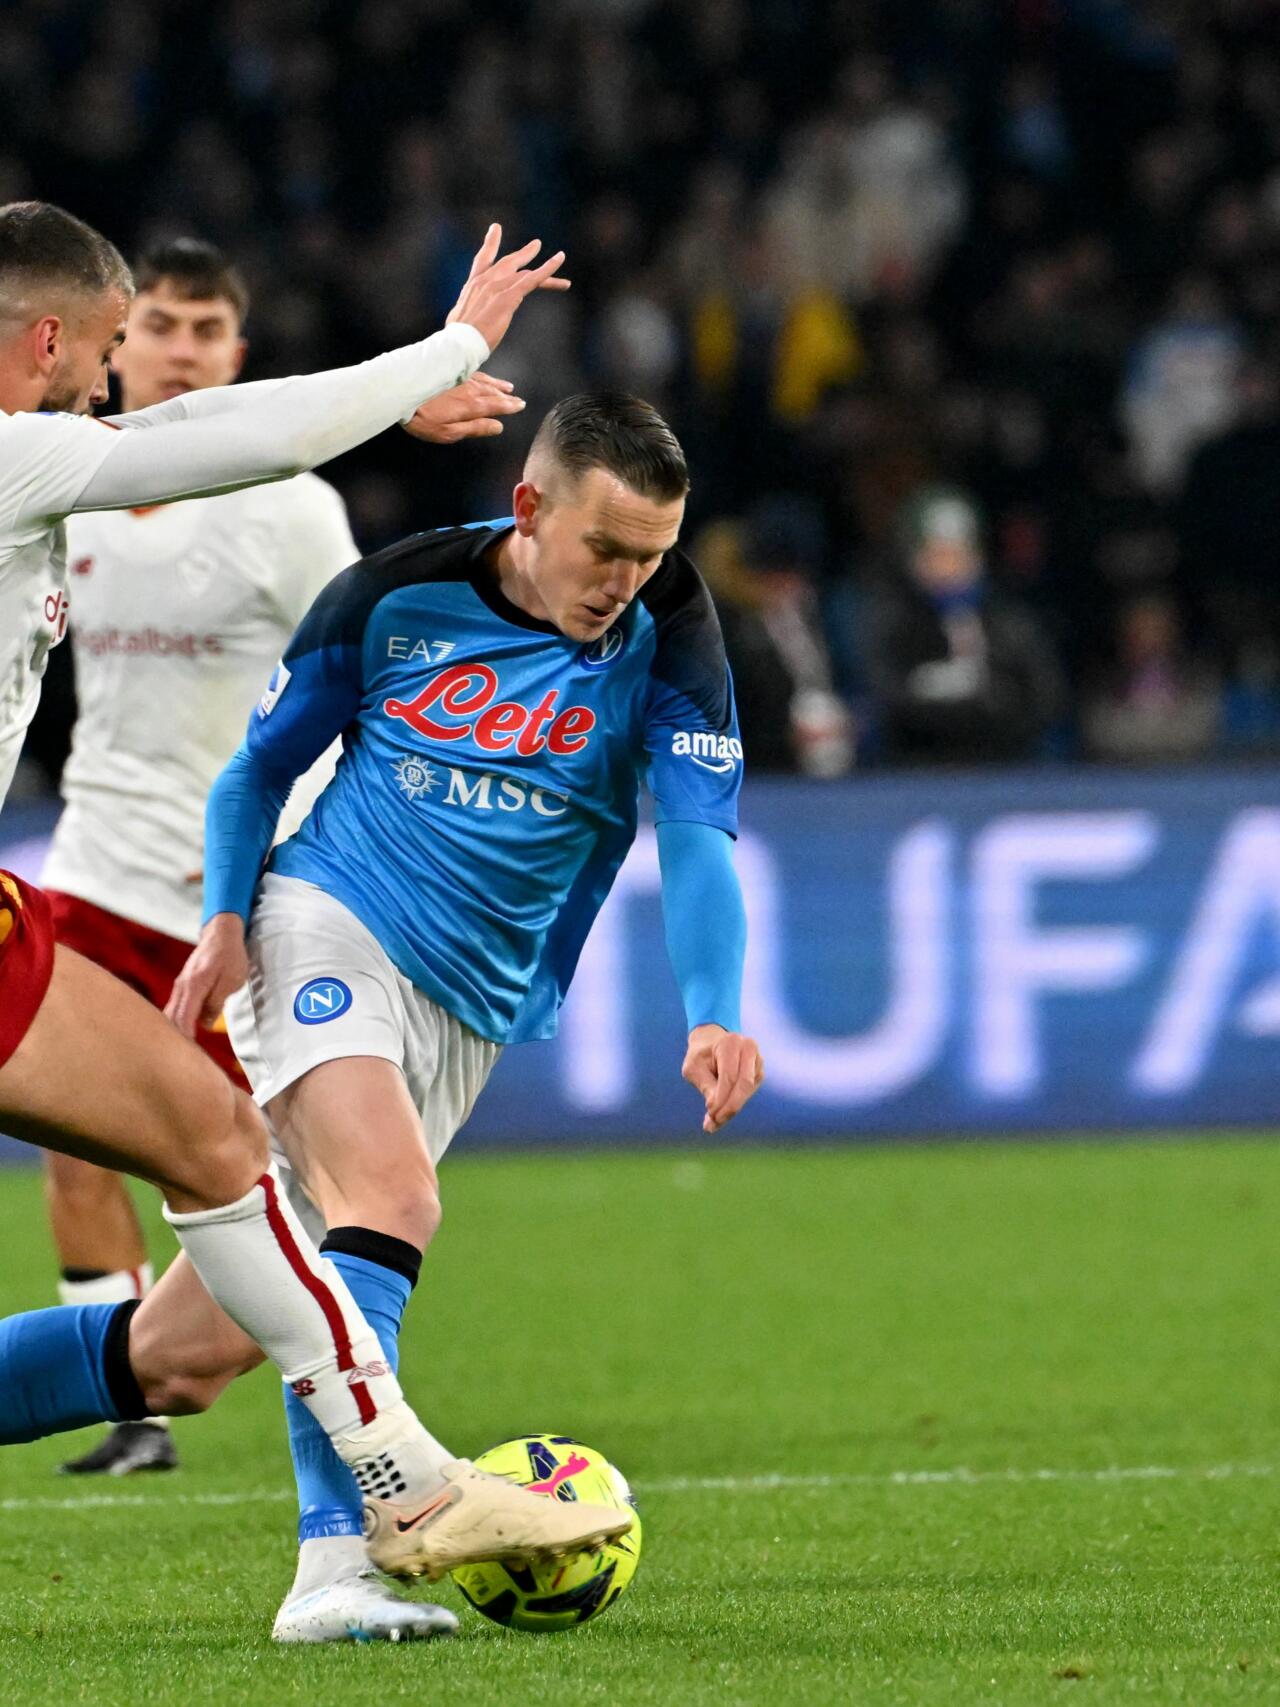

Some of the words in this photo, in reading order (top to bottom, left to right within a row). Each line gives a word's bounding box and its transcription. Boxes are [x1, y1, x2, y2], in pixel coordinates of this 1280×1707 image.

[387, 636, 457, 664] EA7
[383, 662, 597, 757] Lete
[442, 767, 569, 817] MSC
